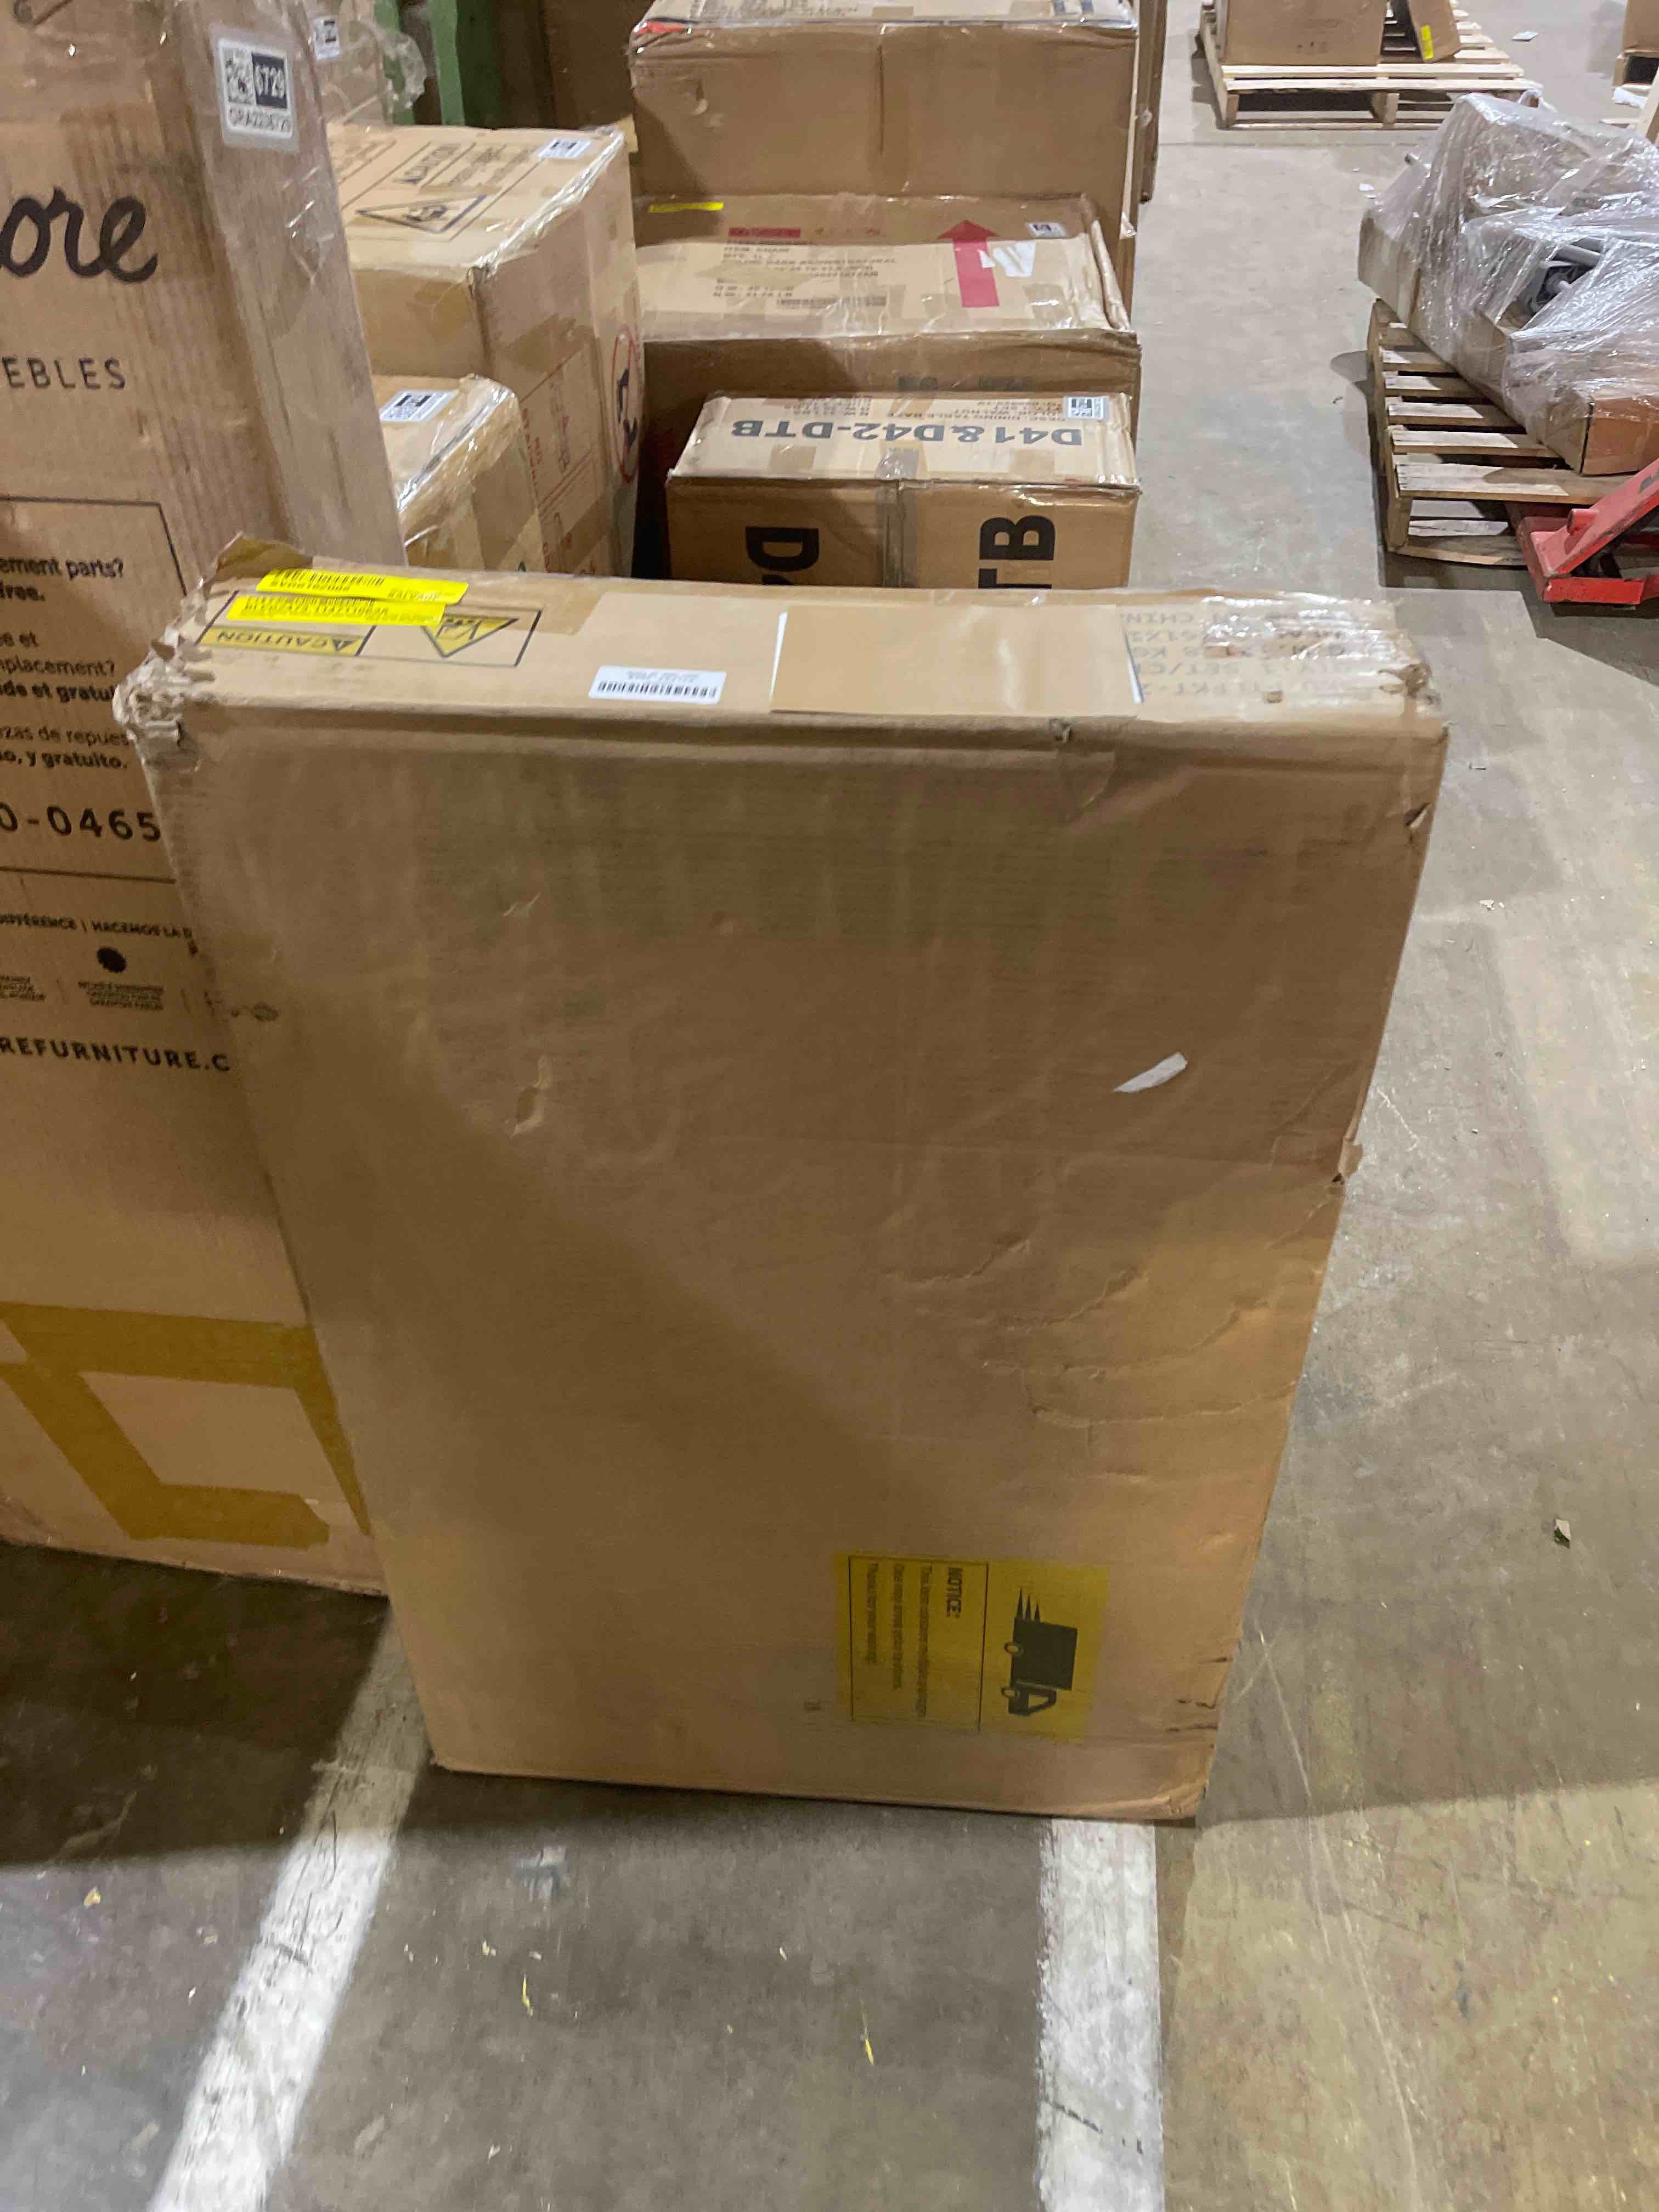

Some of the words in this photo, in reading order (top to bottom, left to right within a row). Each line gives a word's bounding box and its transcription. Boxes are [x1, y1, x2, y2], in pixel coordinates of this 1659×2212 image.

[2, 356, 126, 390] EBLES
[65, 556, 123, 581] parts?
[217, 631, 330, 649] CAUTION
